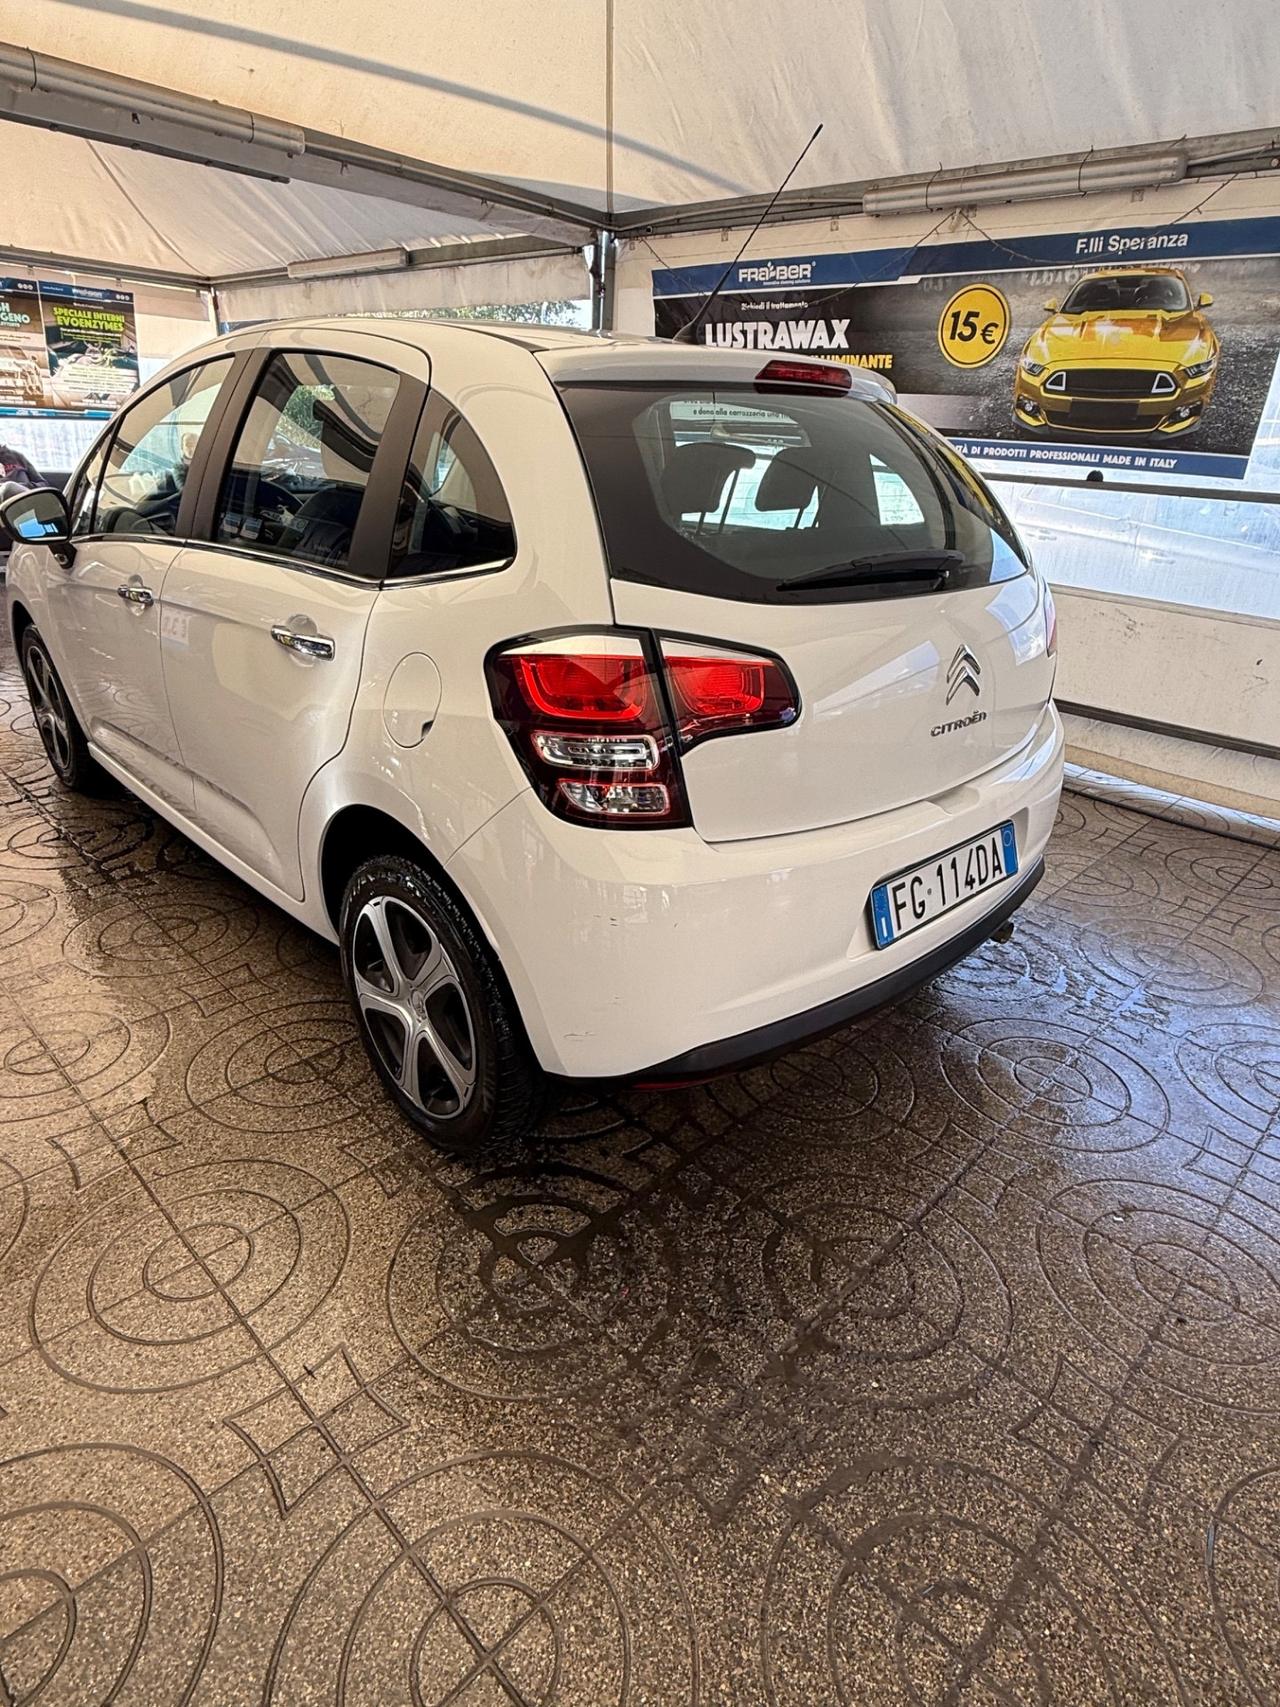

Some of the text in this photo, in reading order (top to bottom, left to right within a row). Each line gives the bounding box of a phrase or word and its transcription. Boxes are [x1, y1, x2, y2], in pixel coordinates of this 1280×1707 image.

[1107, 233, 1189, 256] Speranza
[53, 306, 92, 320] SPECIALE
[93, 311, 125, 323] INTERNI
[57, 315, 125, 332] EVOENZYMES
[705, 319, 851, 350] LUSTRAWAX
[811, 354, 893, 369] MINANTE
[971, 445, 982, 455] DI
[983, 446, 1028, 458] PRODOTTI
[1029, 449, 1100, 463] PROFESSIONALI
[1103, 454, 1131, 466] MADE
[1134, 456, 1147, 467] IN
[1149, 457, 1178, 469] ITALY
